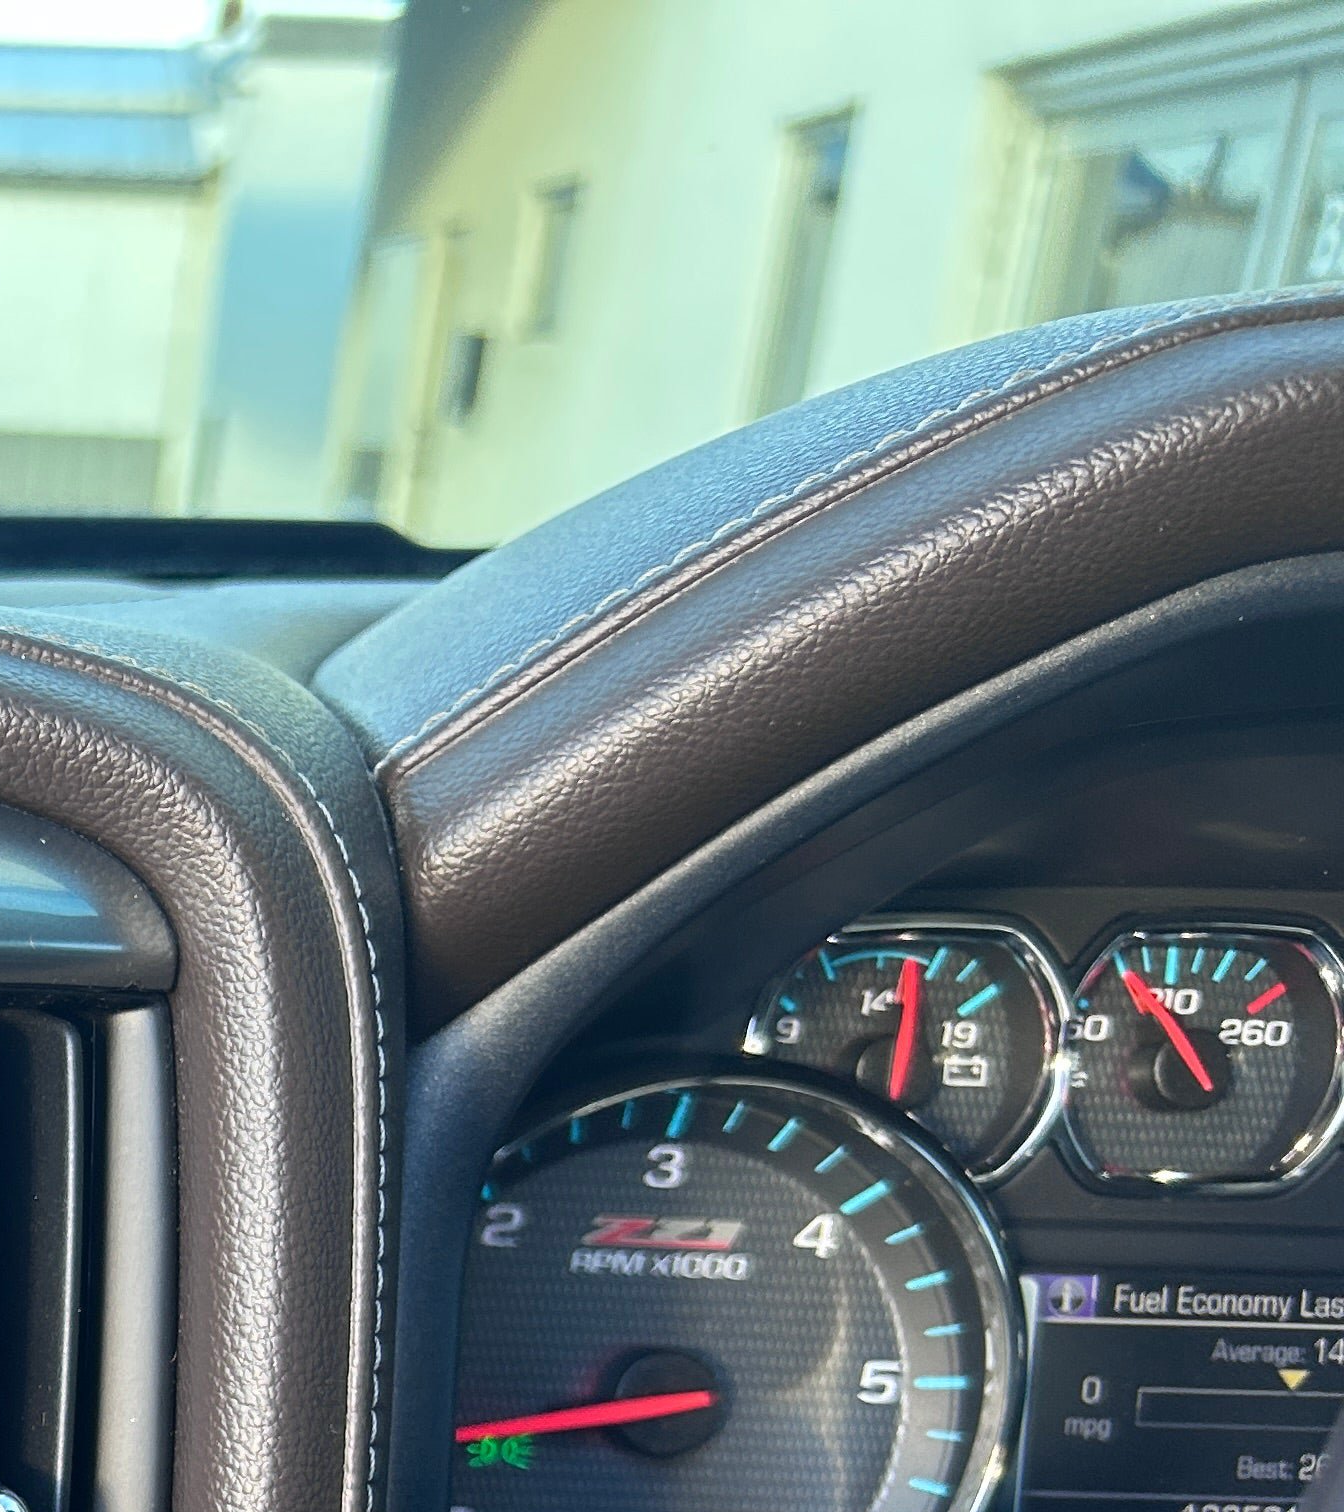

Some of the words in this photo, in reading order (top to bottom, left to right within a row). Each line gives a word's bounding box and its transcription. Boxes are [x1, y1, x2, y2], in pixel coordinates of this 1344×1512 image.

[776, 1016, 801, 1044] 9
[941, 1020, 977, 1049] 19
[1218, 1018, 1293, 1047] 260
[642, 1143, 686, 1189] 3
[481, 1202, 525, 1247] 2
[793, 1212, 841, 1259] 4
[1113, 1282, 1169, 1316] Fuel
[1176, 1283, 1293, 1322] Economy
[856, 1359, 903, 1405] 5
[1080, 1374, 1103, 1405] 0
[1063, 1415, 1113, 1443] mpg
